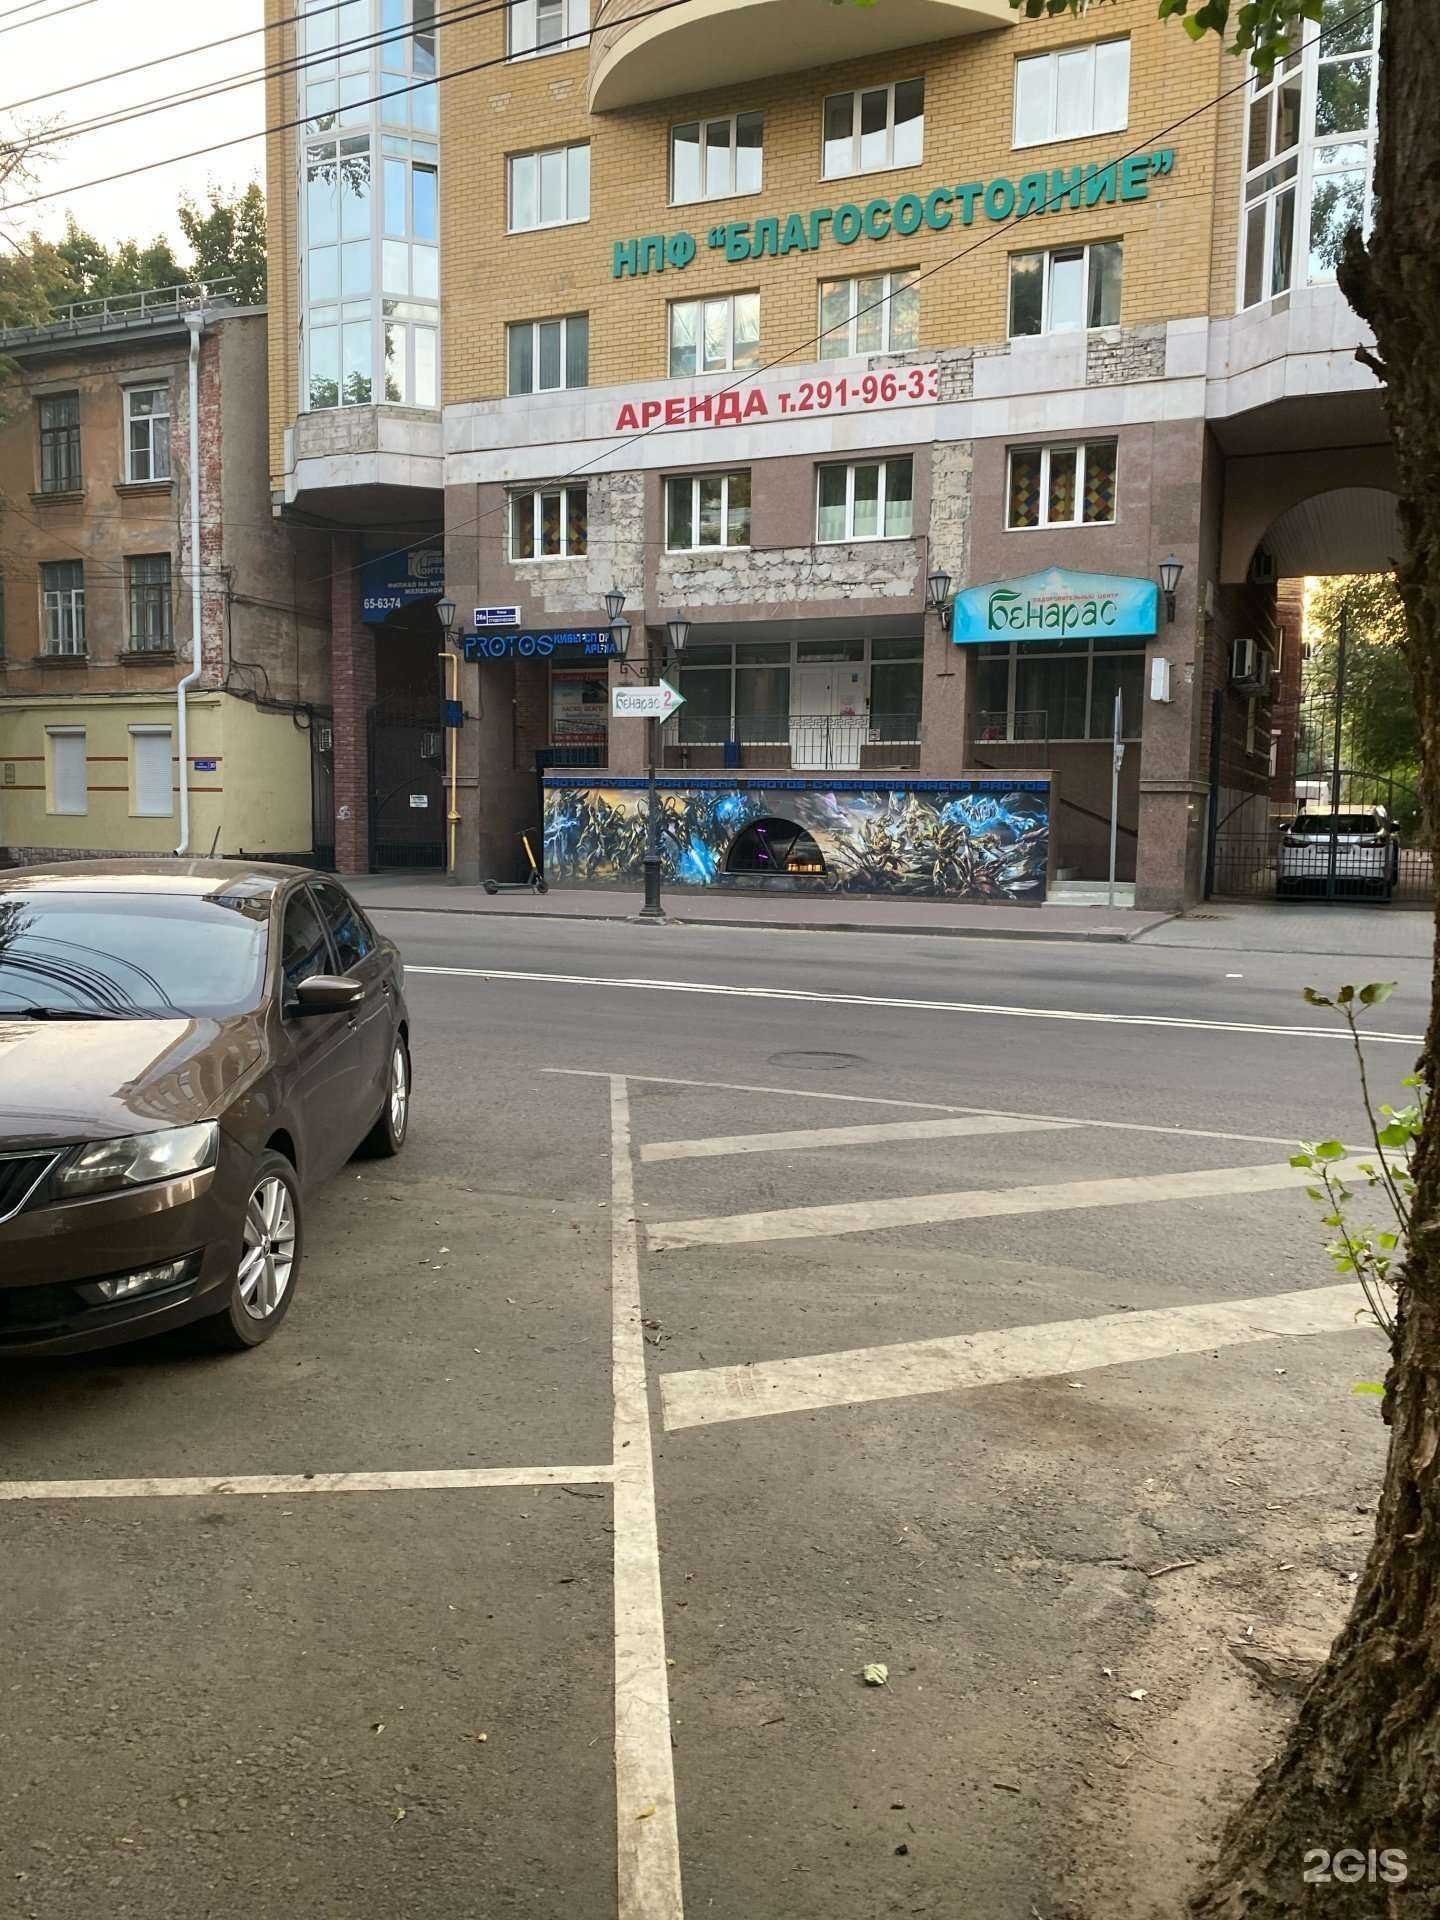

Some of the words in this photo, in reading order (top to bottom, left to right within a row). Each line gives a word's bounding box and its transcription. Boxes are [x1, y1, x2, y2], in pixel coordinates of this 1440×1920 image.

[613, 231, 697, 278] НПФ
[615, 389, 769, 431] АРЕНДА
[363, 597, 401, 610] 65-63-74
[988, 589, 1118, 636] Бенарас
[465, 634, 554, 658] PROTOS
[663, 690, 672, 707] 2
